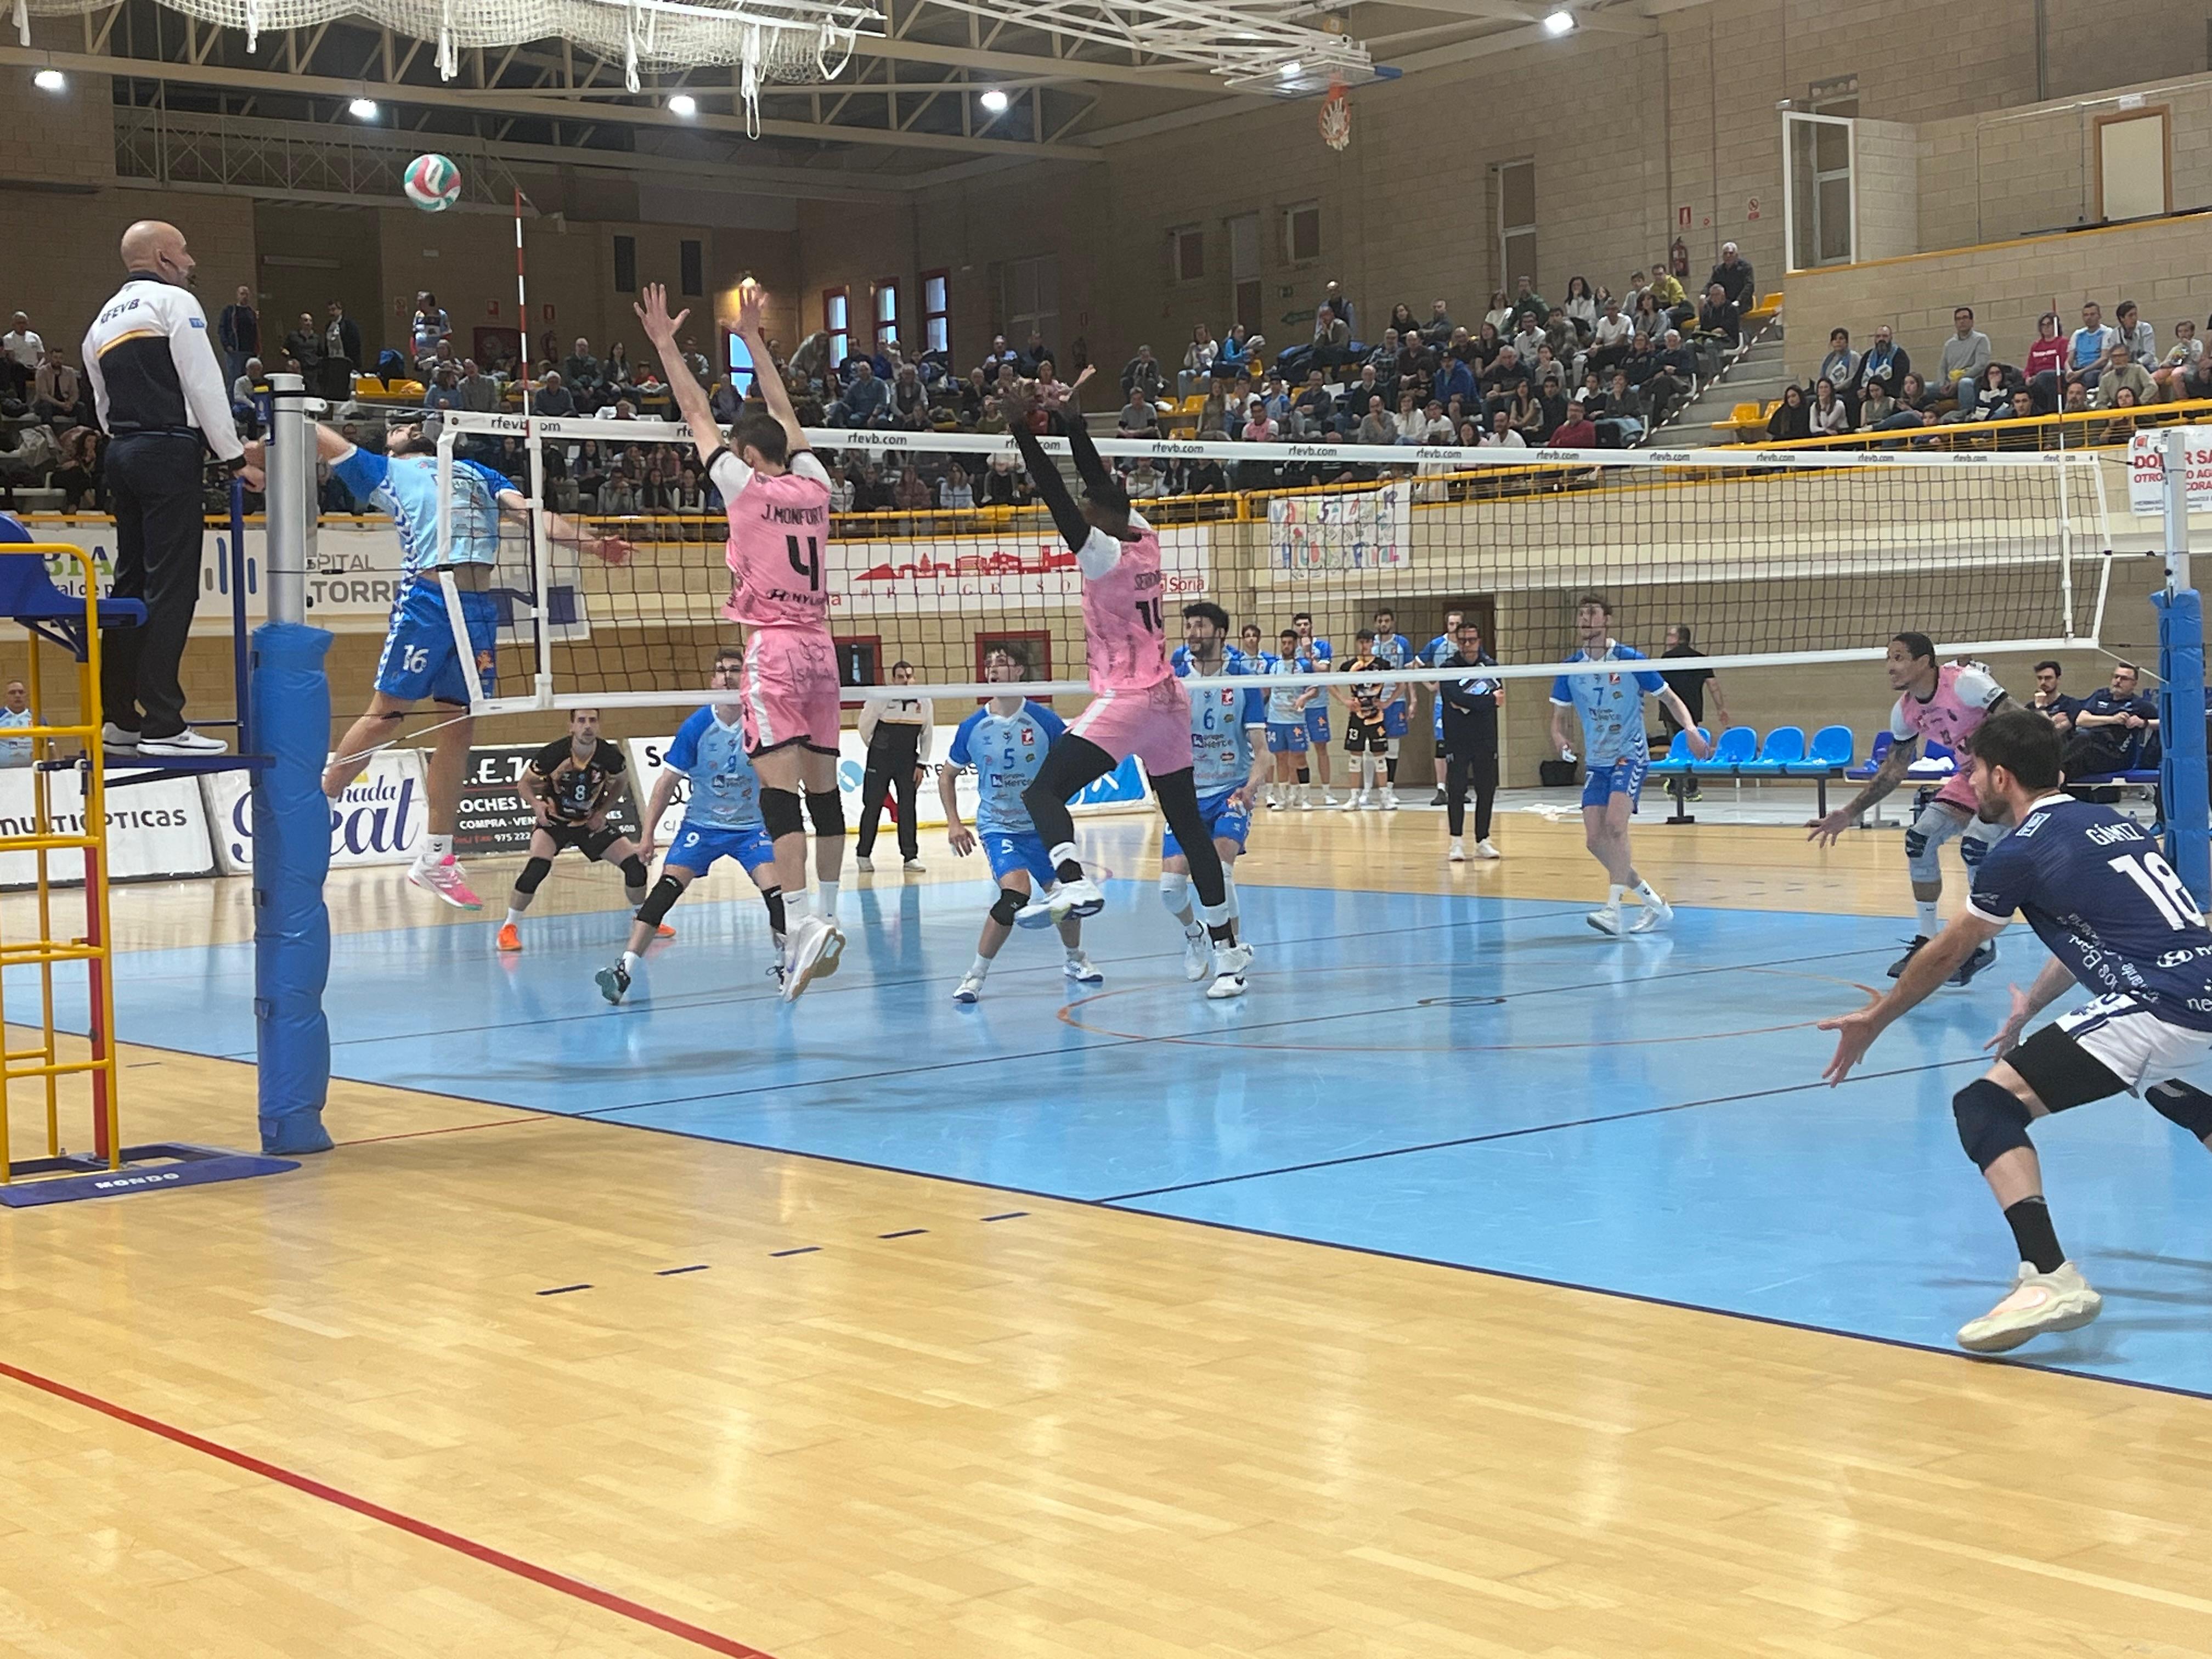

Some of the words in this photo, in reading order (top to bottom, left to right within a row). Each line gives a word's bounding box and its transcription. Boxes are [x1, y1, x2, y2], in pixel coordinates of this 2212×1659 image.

[848, 433, 907, 445] rfevb.com
[1152, 443, 1204, 454] rfevb.com
[1289, 446, 1337, 456] rfevb.com
[1416, 449, 1462, 459] rfevb.com
[2135, 452, 2193, 469] DOR
[786, 535, 819, 591] 4
[403, 644, 430, 674] 16
[1593, 687, 1604, 706] 7
[1204, 708, 1214, 730] 6
[1349, 728, 1359, 741] 13
[1003, 748, 1015, 770] 5
[575, 784, 586, 801] 8
[456, 797, 518, 814] OCHES
[512, 816, 536, 826] VEN
[684, 832, 700, 848] 9
[1001, 839, 1014, 854] 5
[2107, 851, 2207, 931] 18
[94, 1172, 180, 1189] MONDO
